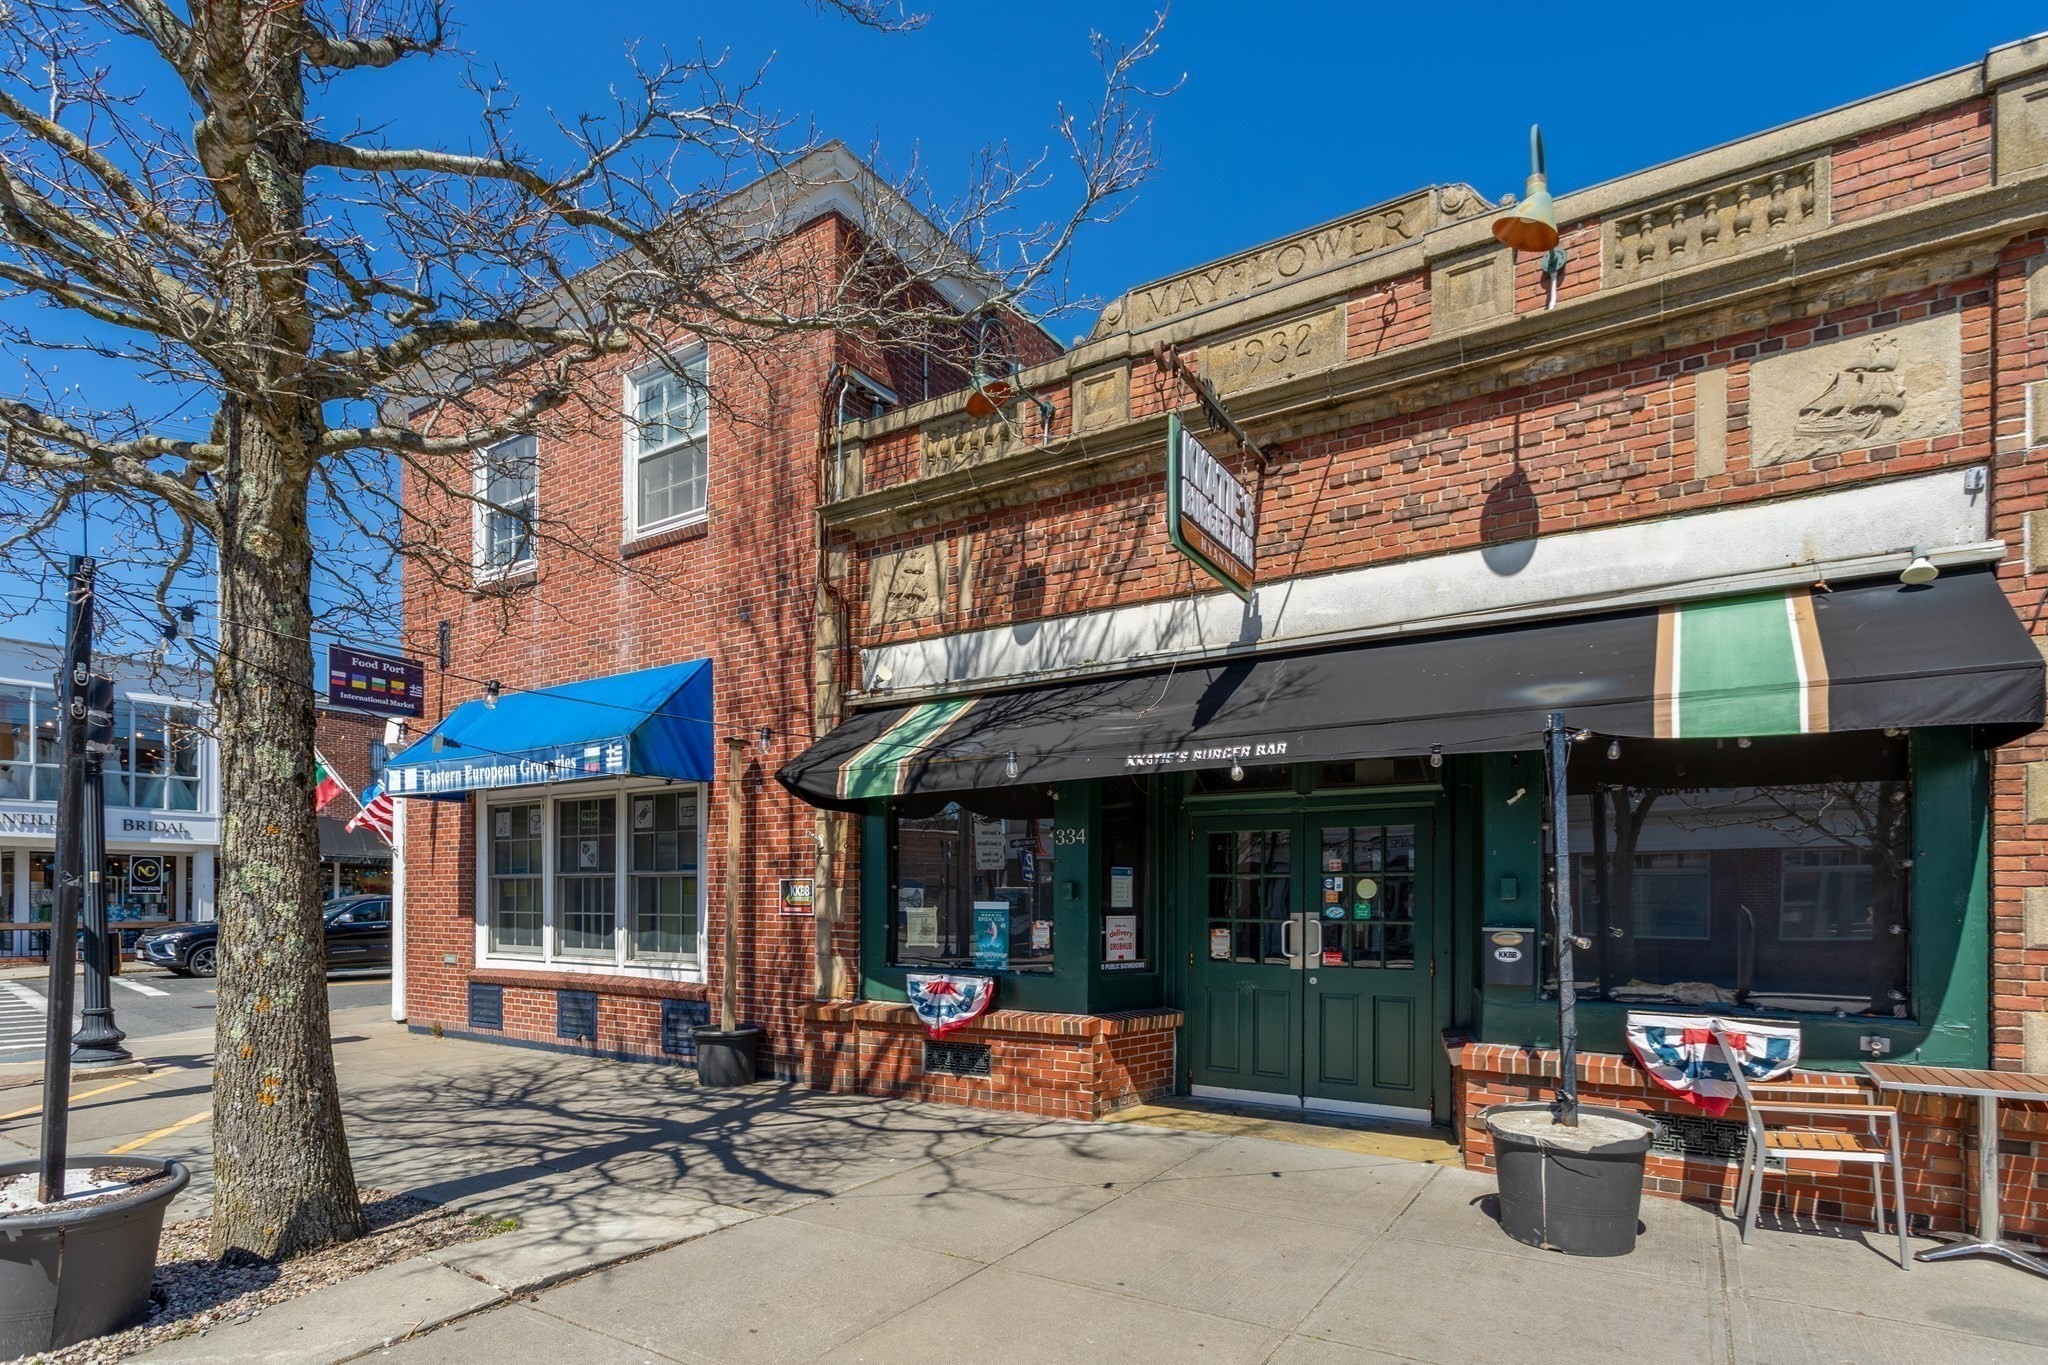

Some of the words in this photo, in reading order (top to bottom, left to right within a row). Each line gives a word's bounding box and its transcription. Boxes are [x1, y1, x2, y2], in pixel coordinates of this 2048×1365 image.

[1144, 209, 1413, 323] MAYFLOWER
[1229, 323, 1312, 377] 1932
[1182, 429, 1255, 538] KKATIE'S
[1182, 478, 1232, 550] BURGER
[1231, 523, 1254, 570] BAR
[1201, 536, 1239, 578] HYANNIS
[351, 657, 378, 670] Food
[382, 663, 405, 675] Port
[340, 691, 389, 705] International
[389, 699, 415, 710] Market
[1125, 750, 1190, 767] KKATIE'S
[1191, 745, 1252, 762] BURGER
[1255, 741, 1288, 756] BAR
[423, 768, 461, 786] Eastern
[464, 763, 516, 783] European
[519, 754, 577, 776] Grocries
[122, 818, 188, 833] BRIDAL
[1055, 828, 1086, 846] 334
[137, 865, 156, 878] NC
[1109, 929, 1133, 938] delivery
